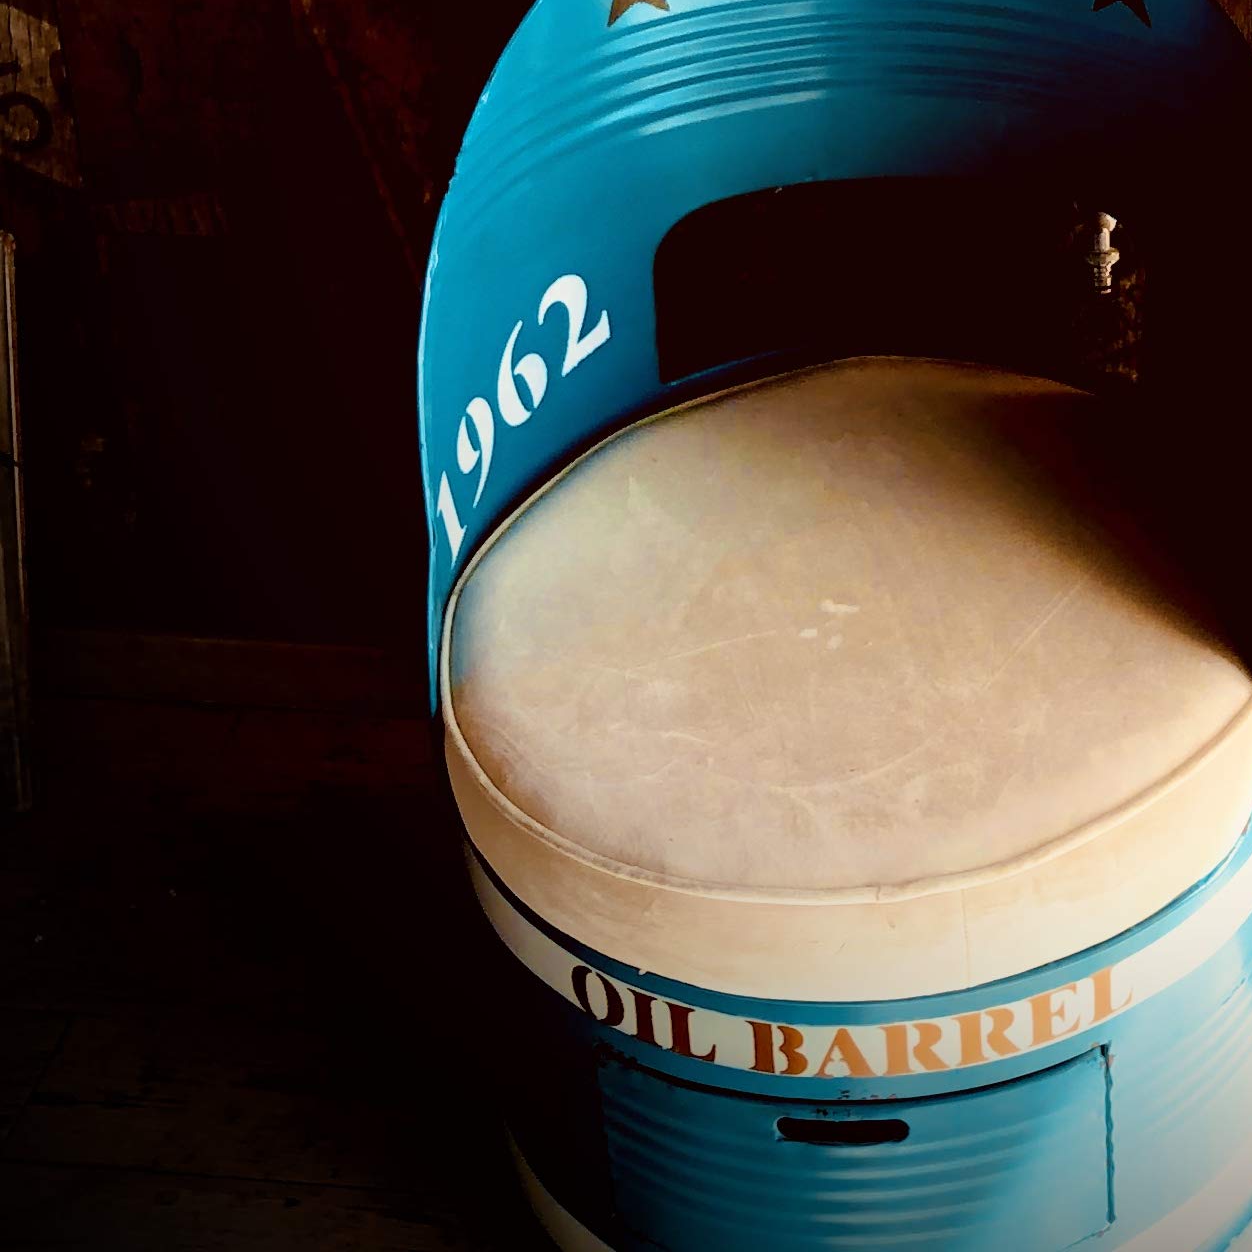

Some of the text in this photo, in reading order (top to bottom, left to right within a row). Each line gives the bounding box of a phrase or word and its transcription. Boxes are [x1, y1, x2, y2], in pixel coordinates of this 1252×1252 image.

[436, 274, 611, 570] 1962
[570, 964, 1134, 1079] OIL BARREL
